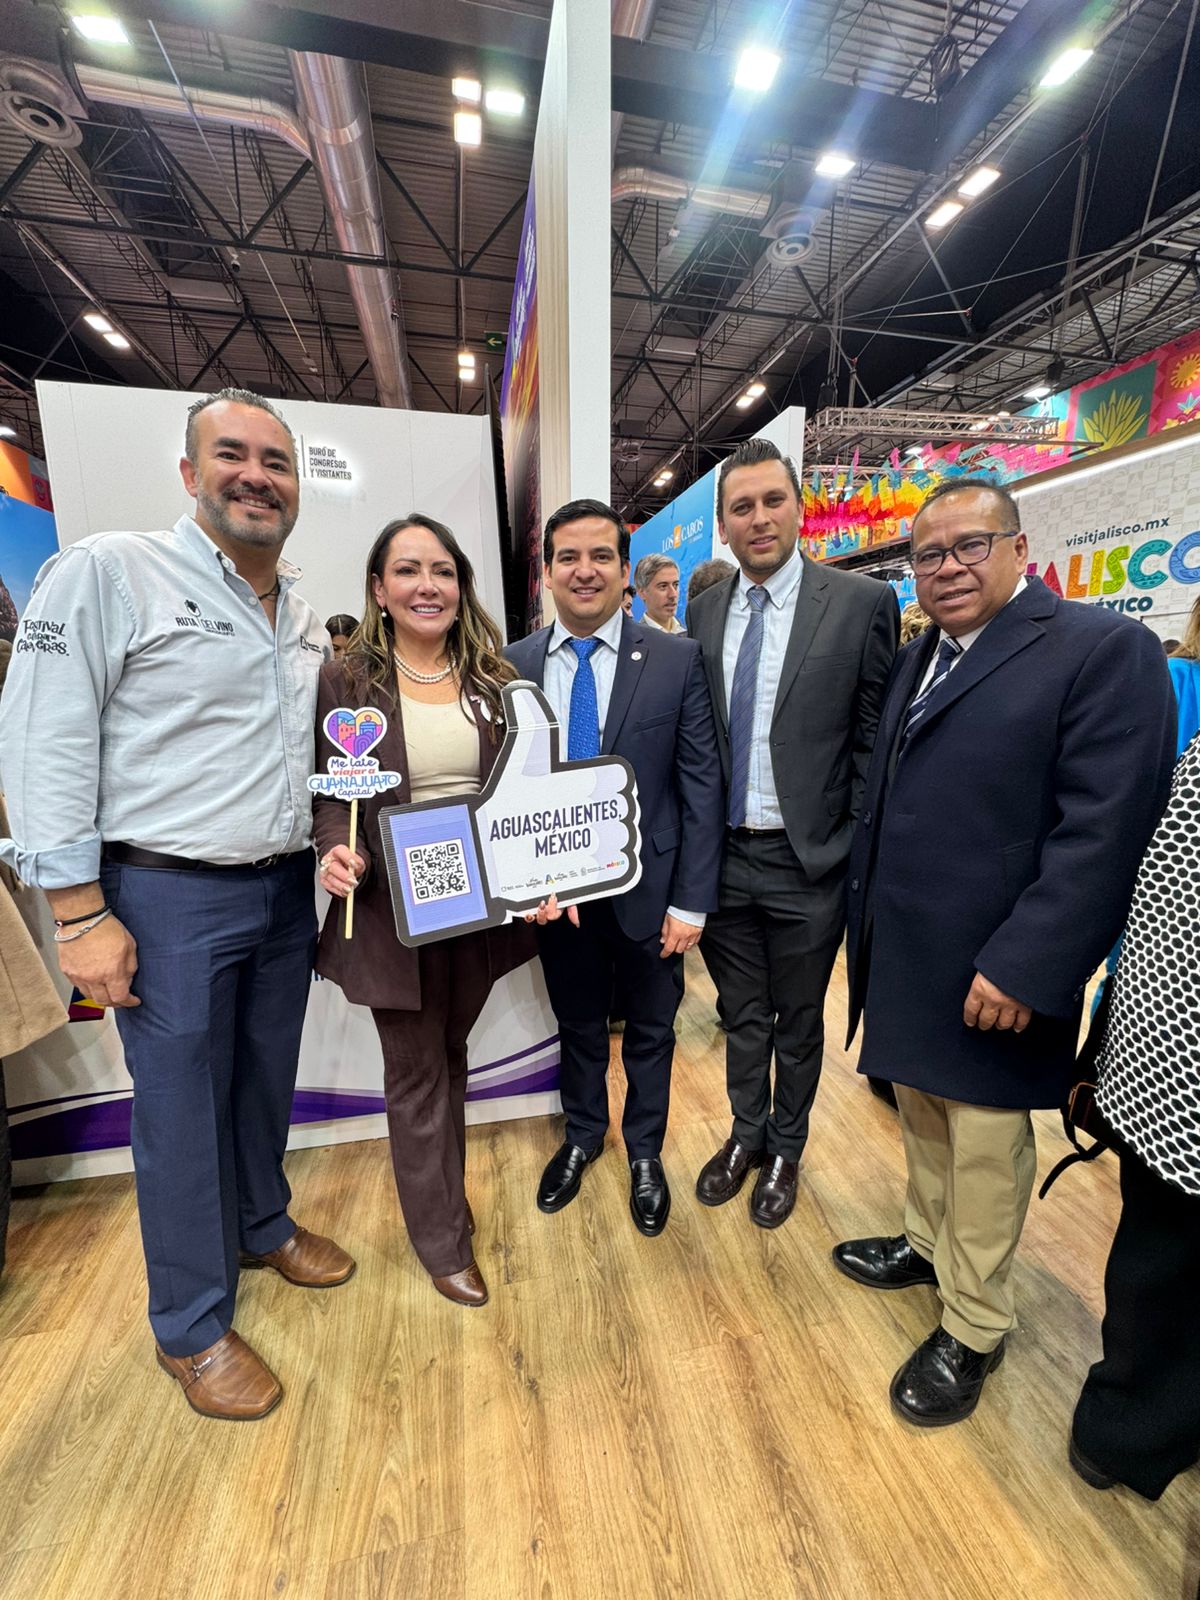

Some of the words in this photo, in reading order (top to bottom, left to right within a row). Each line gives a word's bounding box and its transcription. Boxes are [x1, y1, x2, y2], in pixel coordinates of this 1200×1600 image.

[309, 446, 327, 457] BURÓ
[327, 448, 336, 457] DE
[309, 458, 347, 469] CONGRESOS
[309, 468, 315, 478] Y
[316, 469, 352, 481] VISITANTES
[1066, 517, 1170, 547] visitjalisco.mx
[1025, 530, 1200, 600] ALISCO
[175, 616, 199, 628] RUTA
[213, 620, 234, 632] VINO
[331, 758, 348, 769] Me
[350, 757, 377, 767] late
[333, 768, 367, 777] viajar
[309, 774, 399, 792] GUANAJUATO
[338, 788, 372, 798] Capital
[535, 827, 591, 858] MÉXICO
